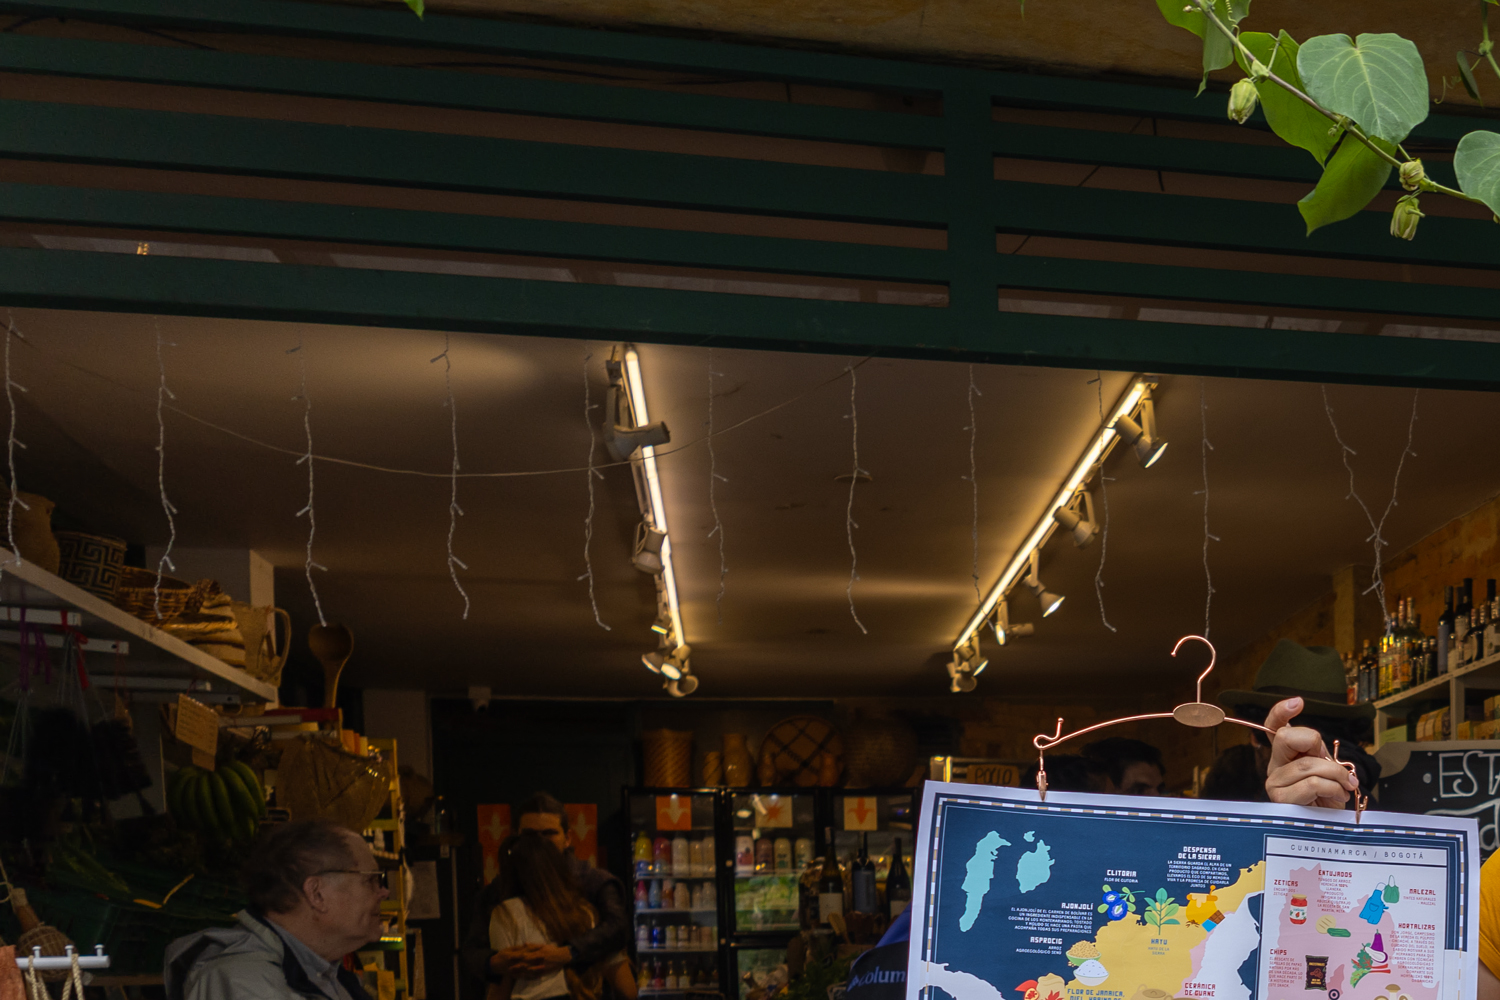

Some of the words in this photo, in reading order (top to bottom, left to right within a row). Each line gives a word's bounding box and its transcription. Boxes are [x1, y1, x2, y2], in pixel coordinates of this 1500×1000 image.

[1290, 844, 1367, 857] CUNDINAMARCA
[1384, 851, 1424, 859] BOGOTÁ
[1197, 853, 1221, 861] SIERRA
[1106, 869, 1136, 877] CLITORIA
[1318, 869, 1352, 878] ENTUJADOS
[1273, 879, 1298, 887] ZETICAS
[1409, 888, 1436, 896] MALEZAL
[1061, 902, 1093, 910] AJONJOLÍ
[1398, 922, 1435, 930] HORTALIZAS
[1184, 982, 1216, 990] CERÁMICA
[1067, 988, 1084, 996] FLOR
[1085, 988, 1094, 996] DE
[1095, 988, 1125, 998] JAMAICA,
[1193, 989, 1215, 997] GUANE
